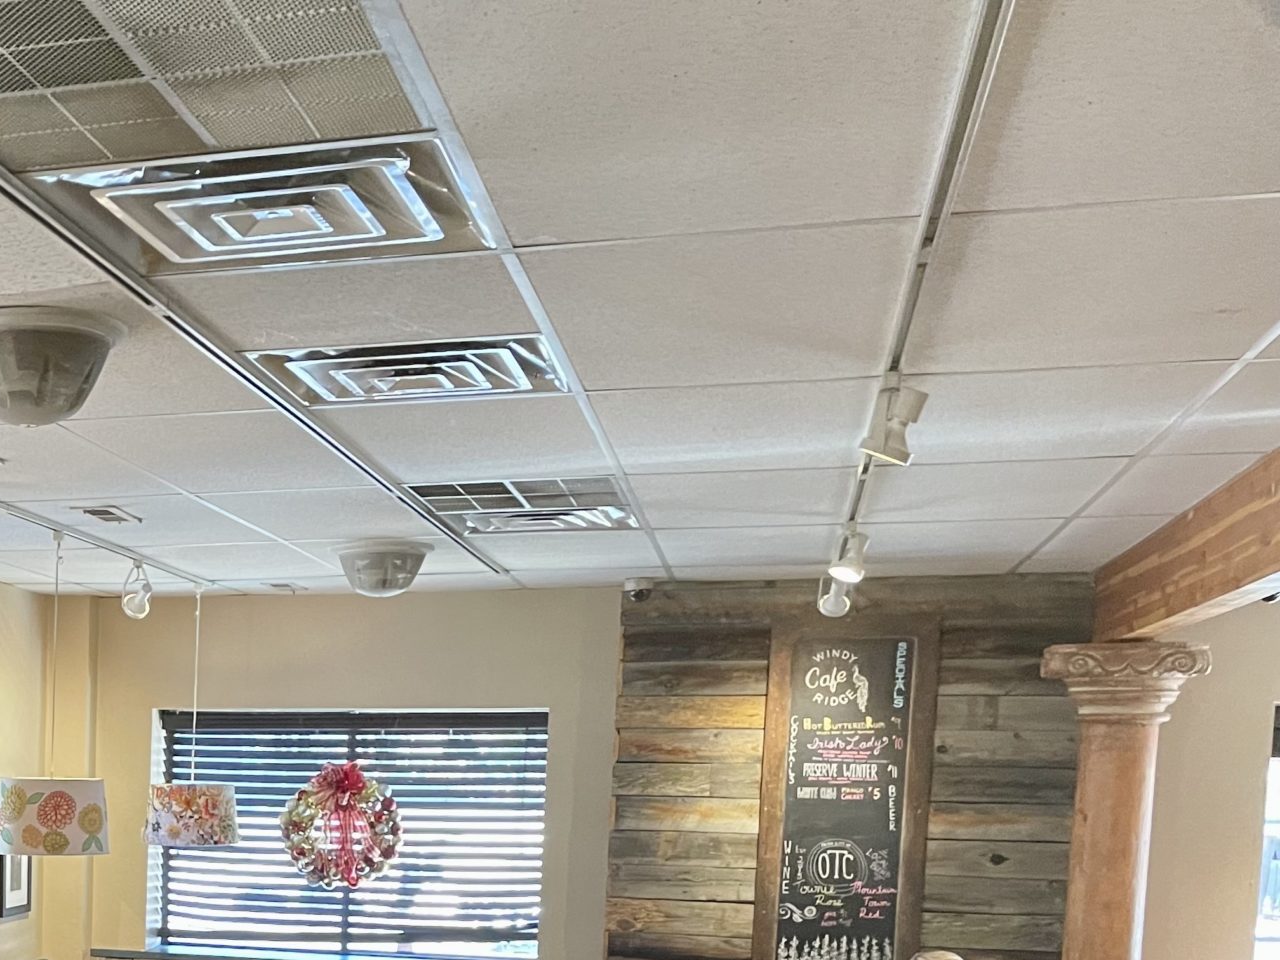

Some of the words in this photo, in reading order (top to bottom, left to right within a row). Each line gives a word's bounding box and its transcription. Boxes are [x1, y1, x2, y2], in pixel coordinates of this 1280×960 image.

[812, 649, 858, 663] WINDY
[812, 689, 857, 706] RIDGE
[788, 715, 799, 784] COCKTAILS
[846, 735, 889, 755] Lady
[802, 763, 838, 777] PRESERVE
[842, 763, 879, 780] WINTER
[888, 785, 897, 831] BEER
[782, 841, 792, 894] WINE
[818, 850, 854, 879] OTC
